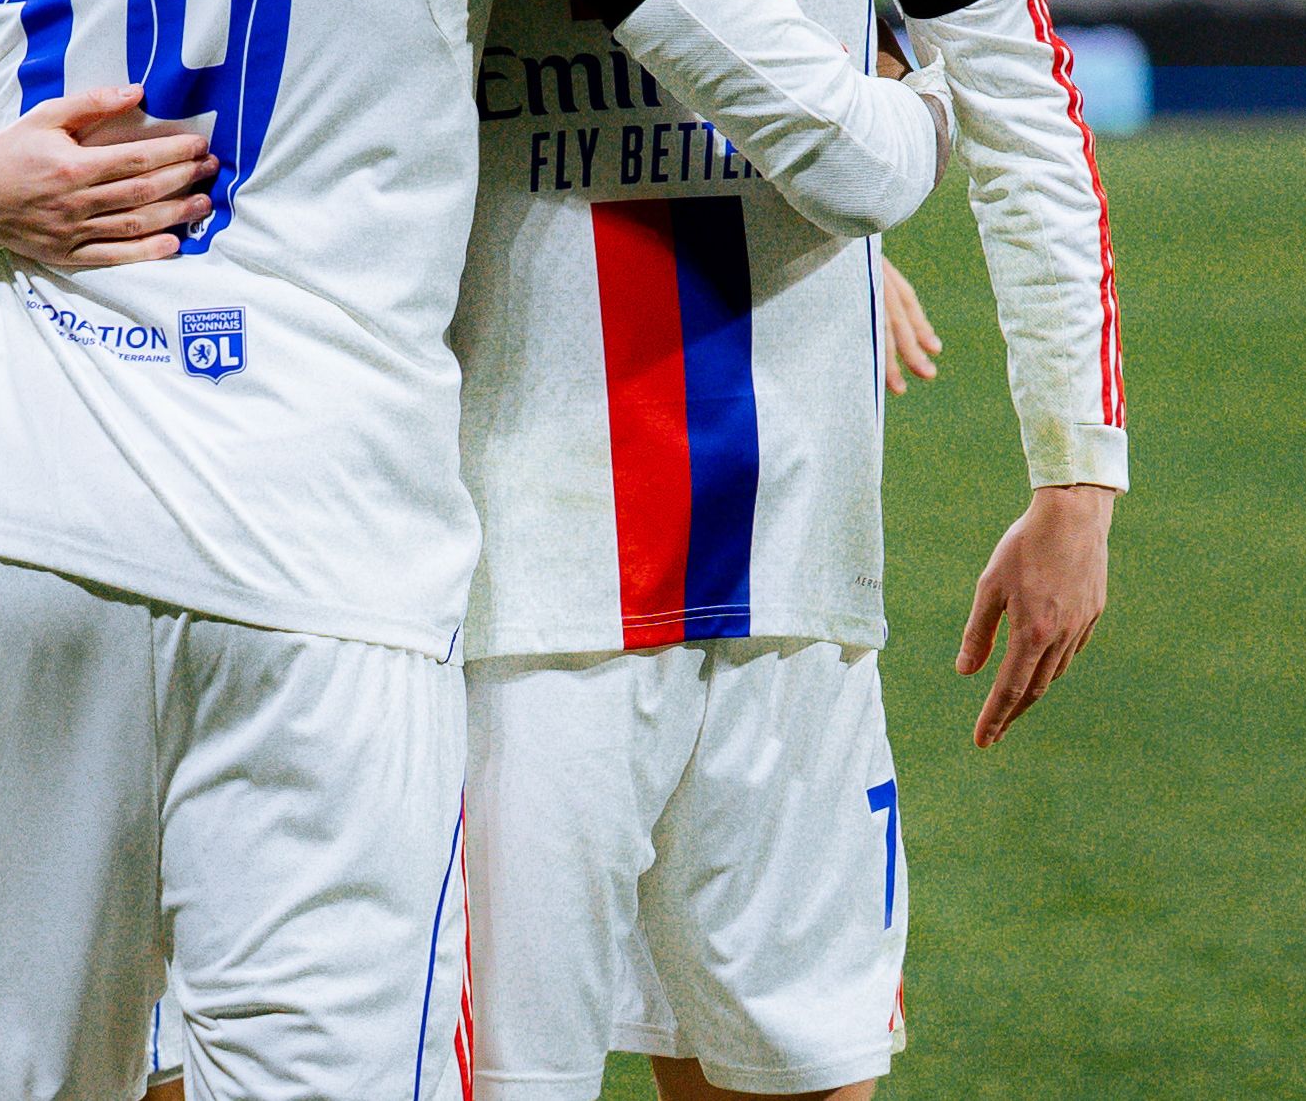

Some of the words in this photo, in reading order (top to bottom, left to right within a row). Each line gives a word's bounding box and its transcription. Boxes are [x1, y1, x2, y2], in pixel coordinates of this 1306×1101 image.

[529, 127, 600, 192] FLY
[184, 311, 240, 323] OLYMPIQUE
[184, 320, 240, 332] LYONNAIS
[187, 336, 240, 369] OL
[866, 778, 897, 930] 7
